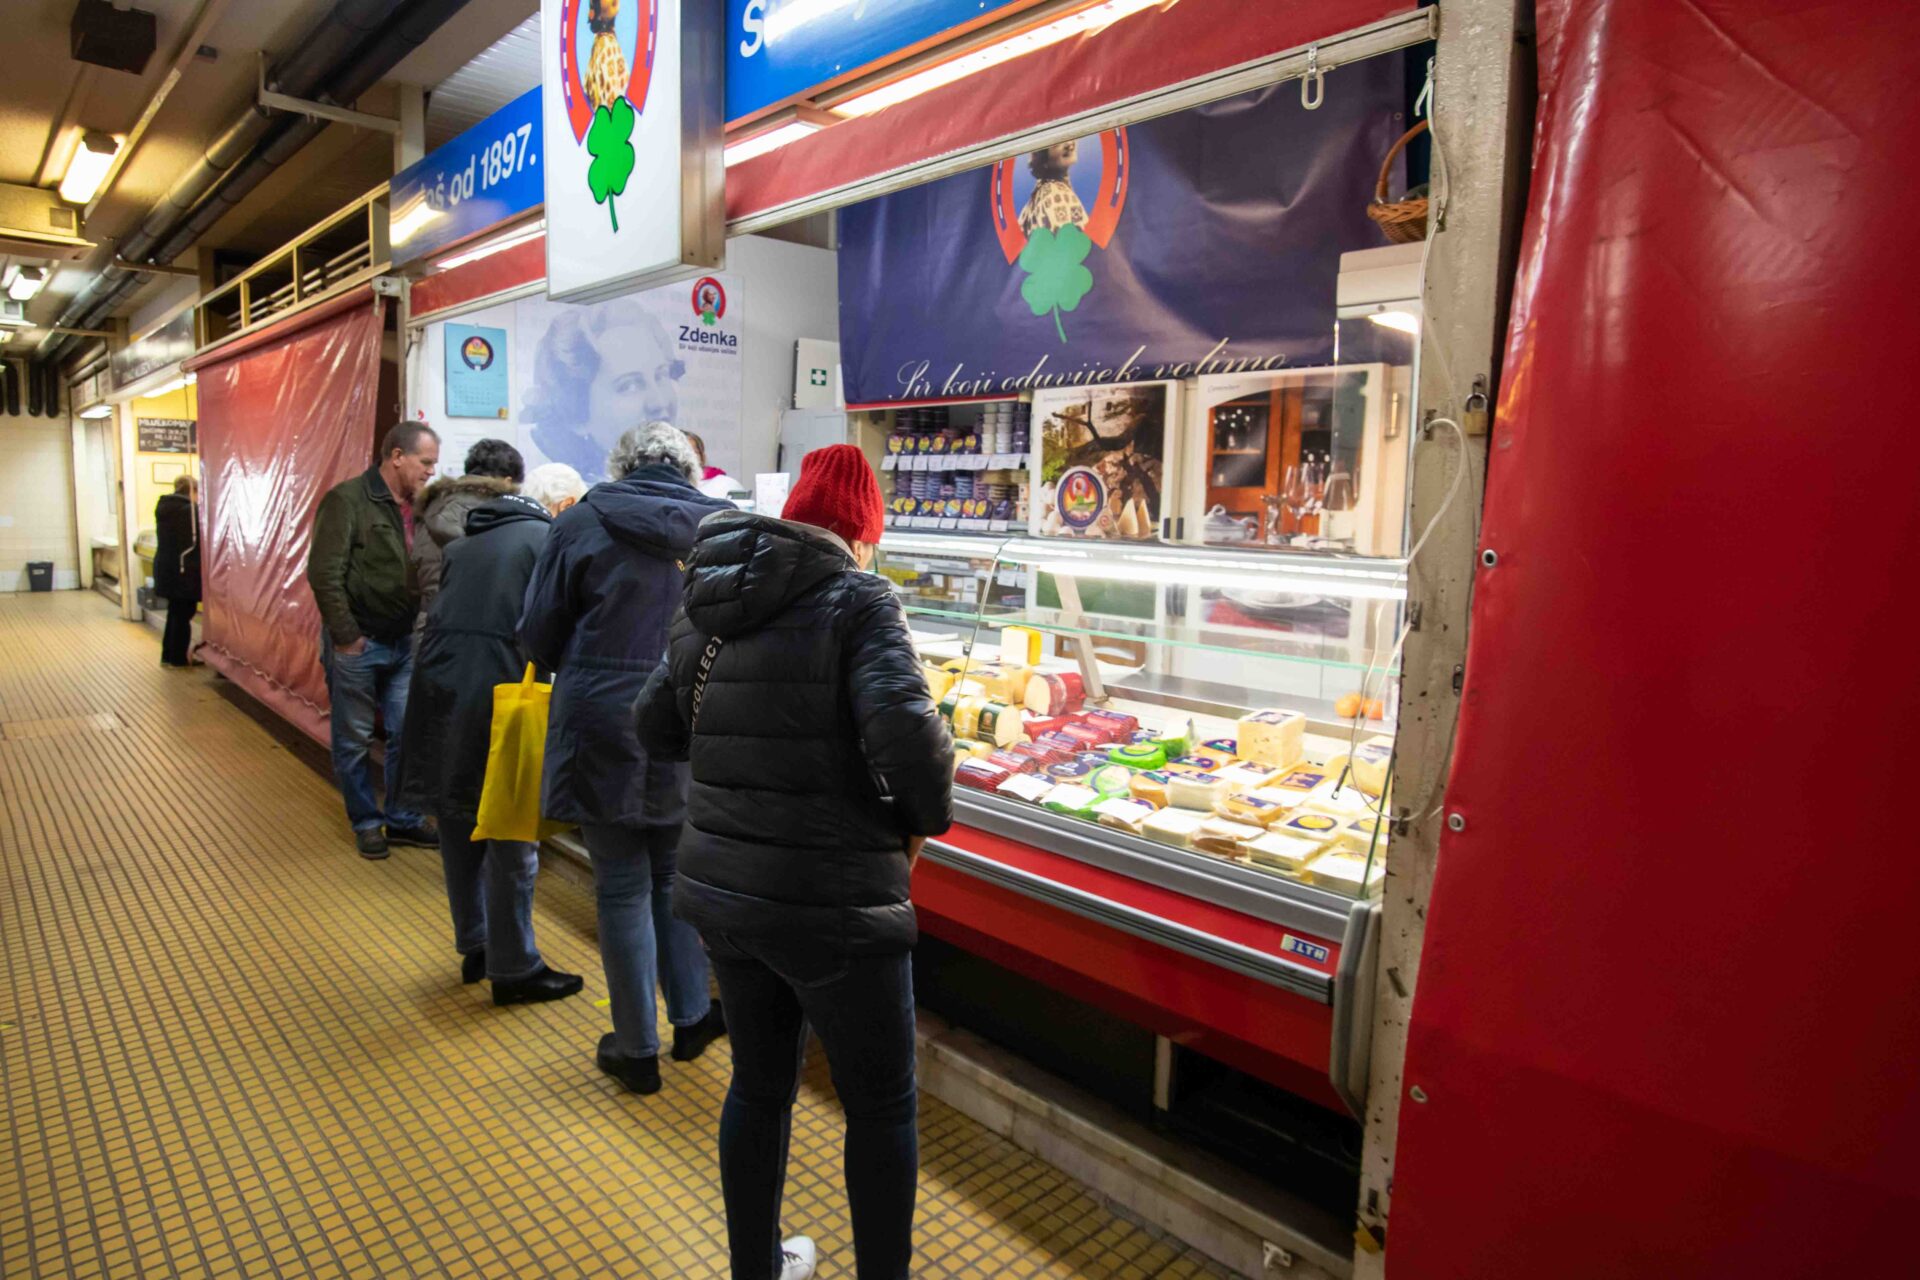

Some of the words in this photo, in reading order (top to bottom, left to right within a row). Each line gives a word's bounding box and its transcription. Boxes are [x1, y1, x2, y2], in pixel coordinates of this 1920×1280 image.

[449, 154, 476, 206] od
[480, 122, 536, 190] 1897.
[679, 325, 737, 347] Zdenka
[889, 359, 934, 401] Sir
[941, 362, 998, 396] koji
[1001, 344, 1143, 389] oduvijek
[1296, 942, 1325, 960] LTH
